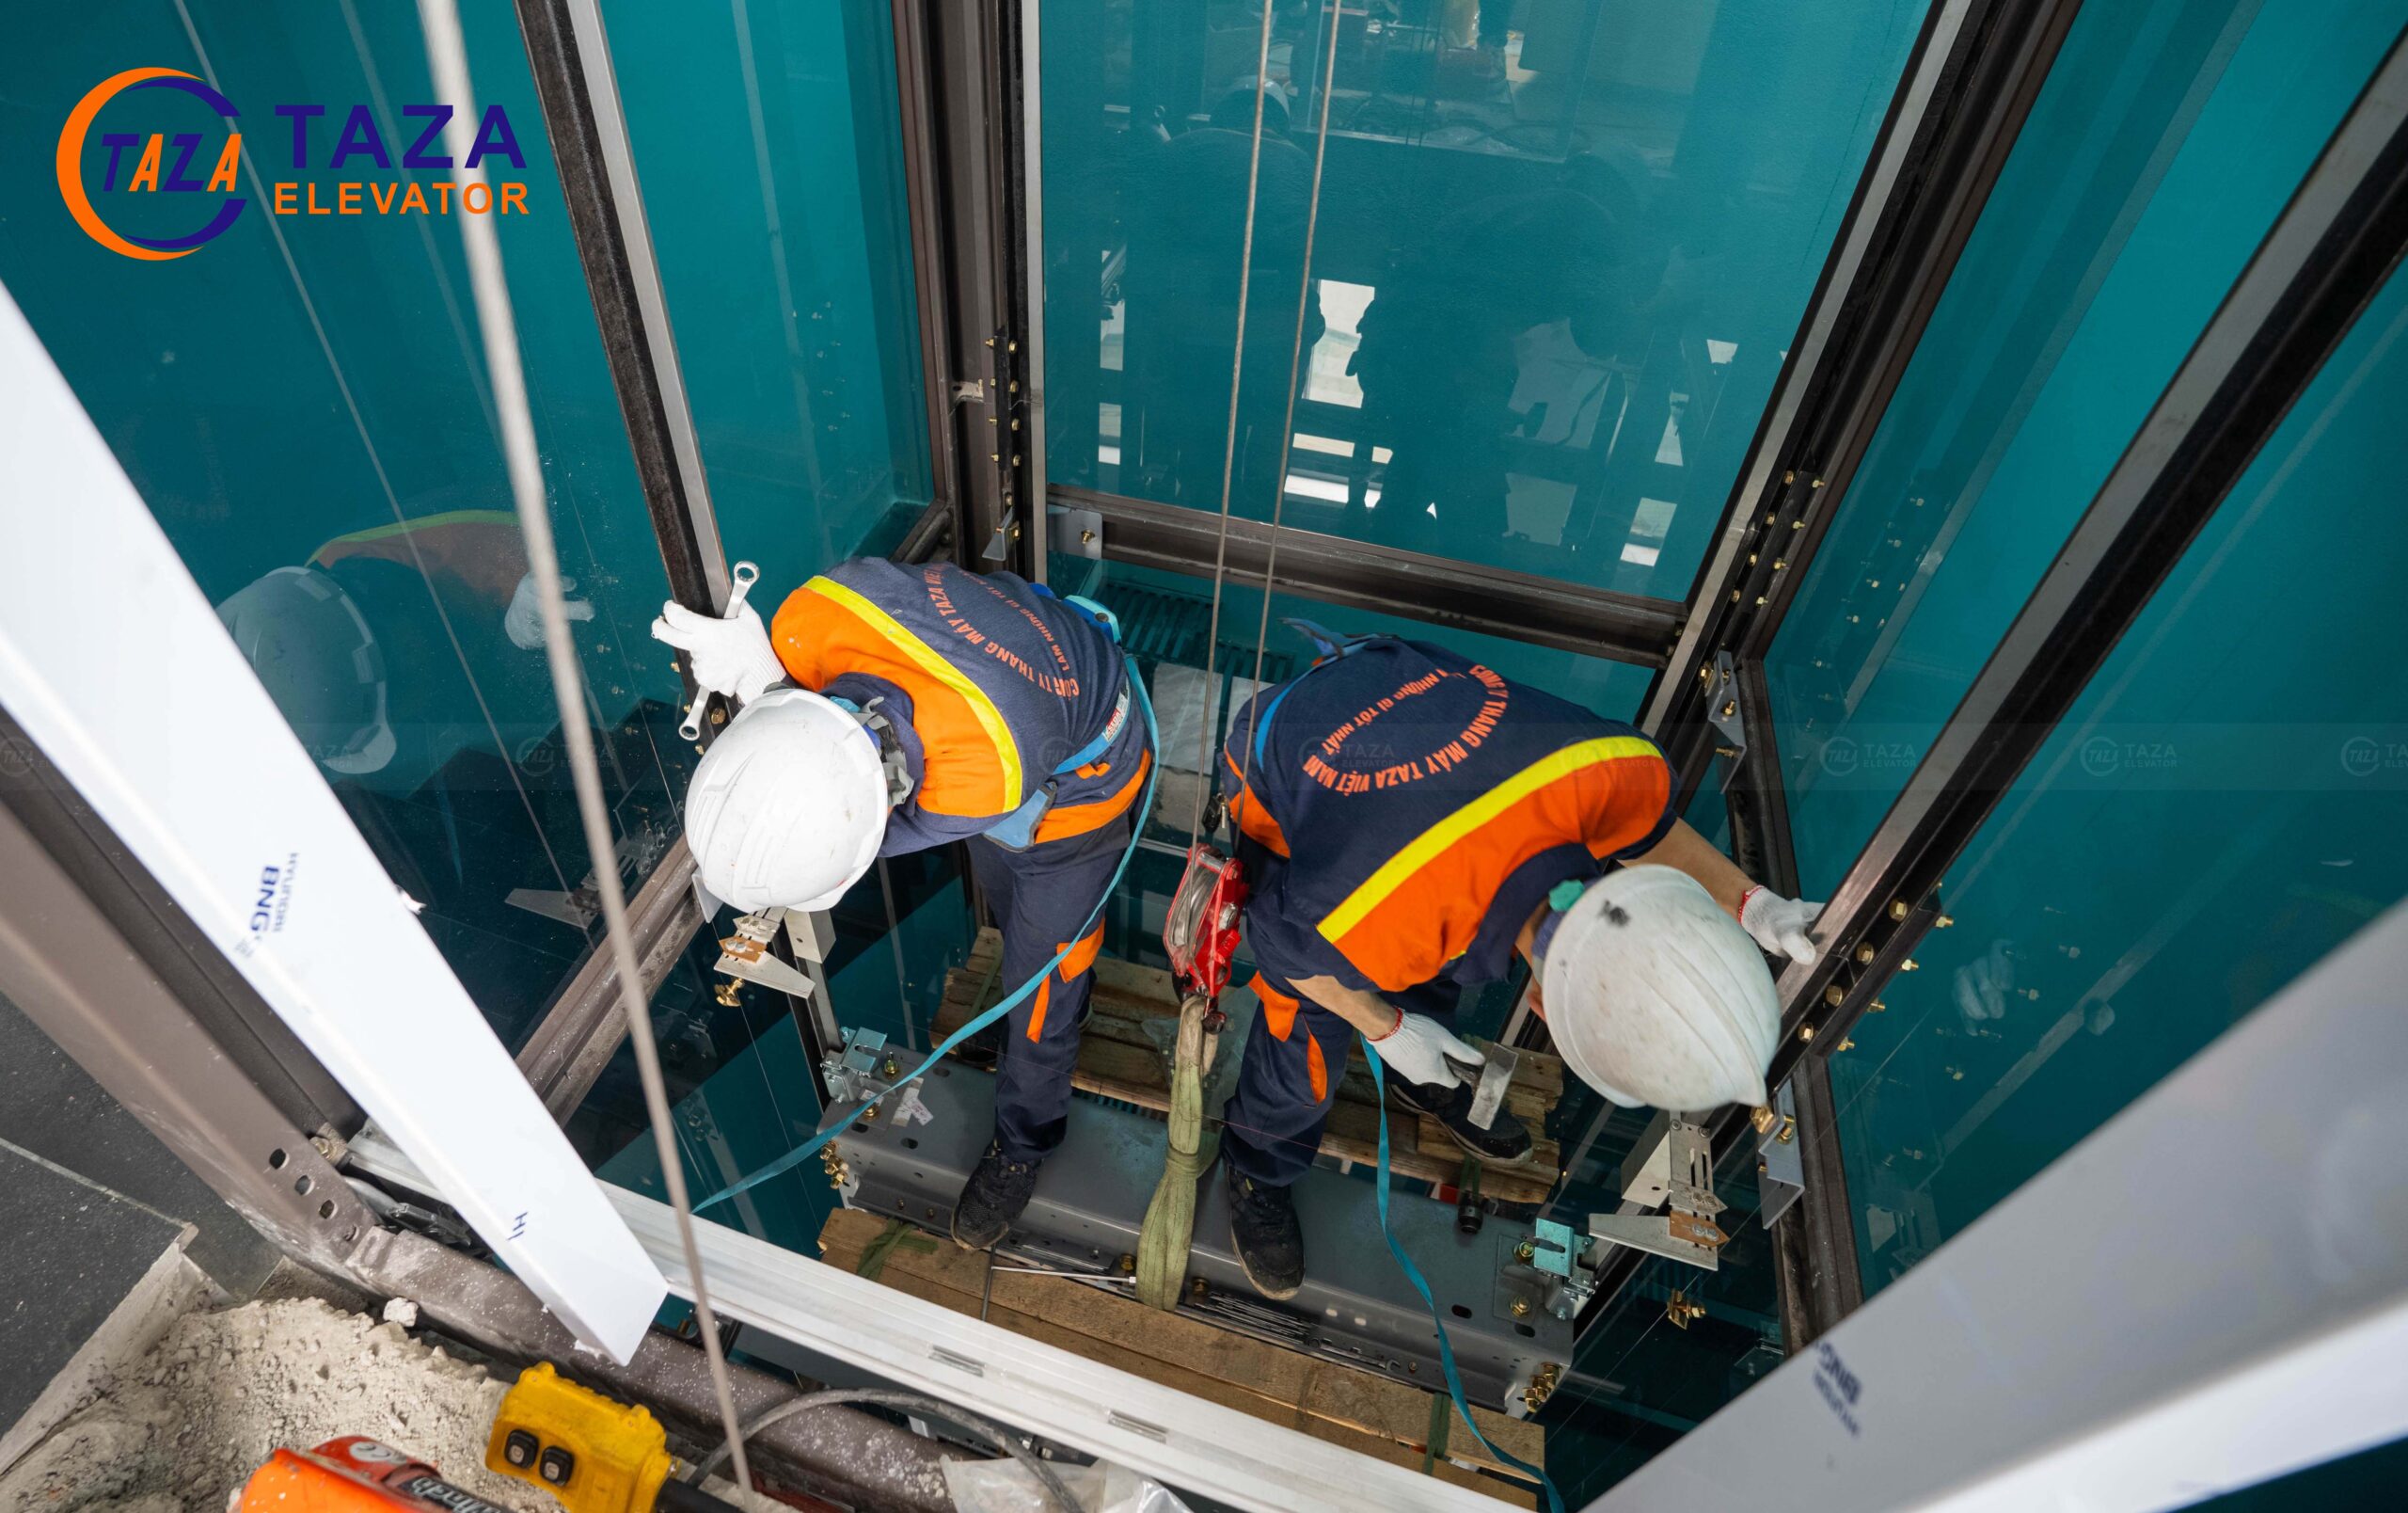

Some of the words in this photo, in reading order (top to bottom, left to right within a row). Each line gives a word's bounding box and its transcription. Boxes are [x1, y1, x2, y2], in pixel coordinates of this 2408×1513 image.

[927, 587, 957, 616] TAZA
[948, 618, 986, 645] MÁY
[985, 641, 1036, 682] THANG
[1460, 700, 1508, 748] THANG
[1302, 755, 1339, 788] NAM
[1425, 741, 1468, 775] MÁY
[1336, 770, 1370, 797] VIỆT
[1375, 761, 1424, 789] TAZA
[250, 866, 280, 932] BNG
